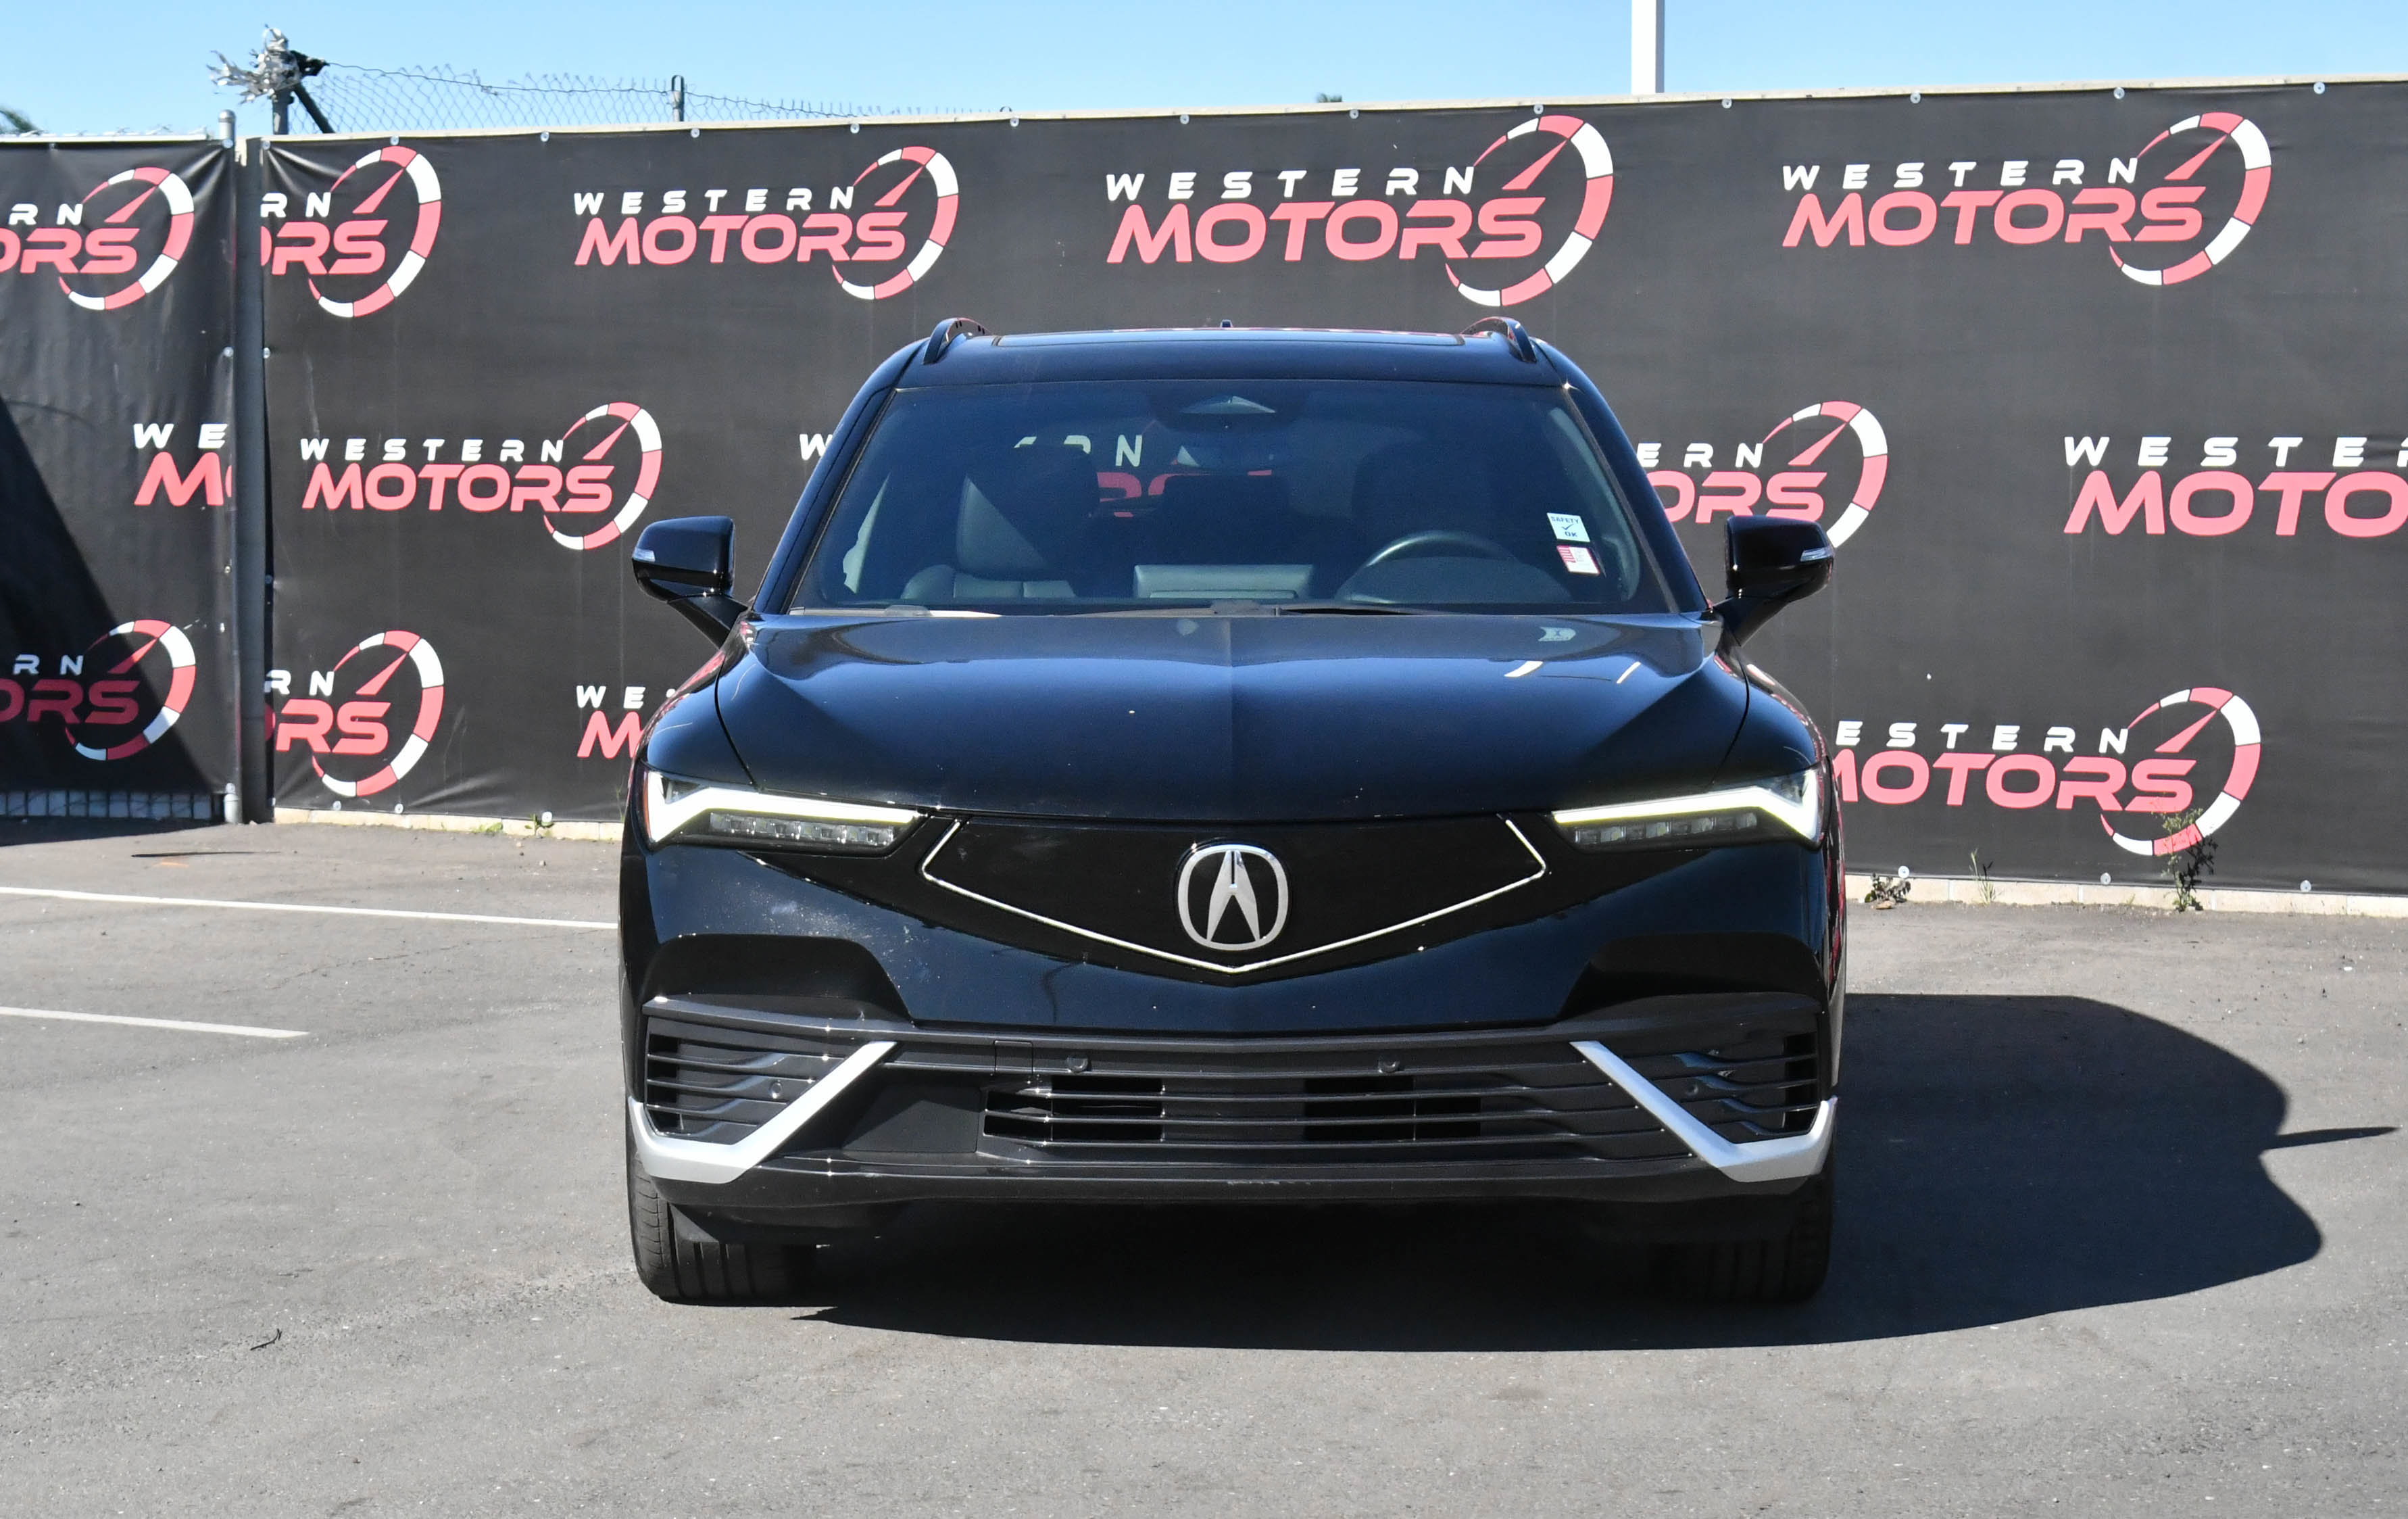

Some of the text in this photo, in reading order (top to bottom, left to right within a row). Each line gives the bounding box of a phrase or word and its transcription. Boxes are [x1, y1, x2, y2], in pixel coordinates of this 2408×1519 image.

[1106, 166, 1475, 201] WESTERN
[1783, 158, 2138, 191] WESTERN
[574, 187, 854, 215] WESTERN
[1782, 186, 2207, 248] MOTORS
[260, 219, 389, 276] RS
[574, 211, 909, 266] MOTORS
[1106, 197, 1547, 264] MOTORS
[301, 438, 564, 463] WESTERN
[134, 452, 232, 506] M
[301, 462, 616, 513] MOTORS
[2064, 471, 2408, 538] MOTO
[1550, 516, 1579, 524] SAFETY
[576, 685, 676, 708] WE
[265, 698, 391, 756] RS
